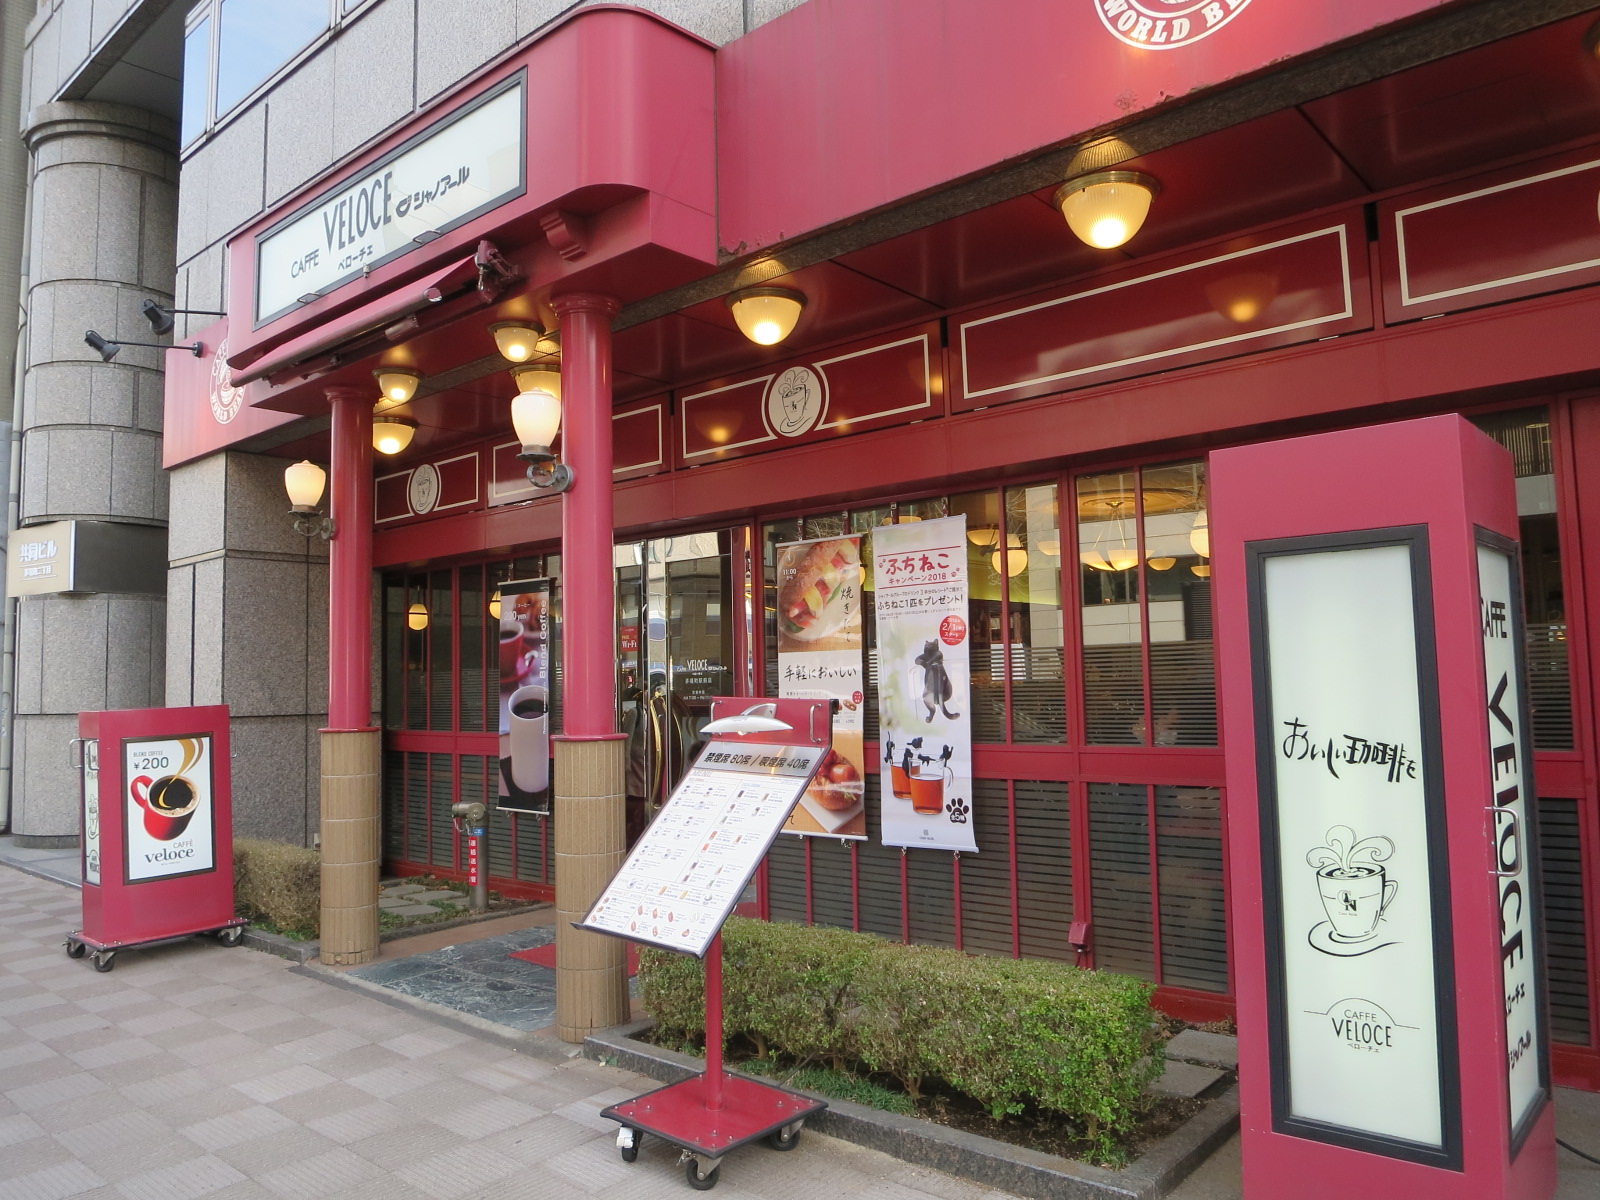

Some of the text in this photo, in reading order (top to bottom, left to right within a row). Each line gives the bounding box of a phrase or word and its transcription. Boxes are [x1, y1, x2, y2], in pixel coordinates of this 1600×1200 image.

[1103, 0, 1190, 43] WORLD
[413, 166, 470, 211] シャノアール
[323, 170, 393, 255] VELOCE
[290, 248, 320, 279] CAFFE
[337, 245, 373, 271] ベローチェ
[19, 540, 58, 563] 共同ビル
[885, 553, 950, 576] ふちねこ
[887, 572, 948, 586] キャンペーン2018
[539, 600, 547, 640] Coffee
[539, 644, 547, 679] Blend
[687, 659, 708, 671] VELOCE
[784, 664, 857, 682] 手軽においしい
[703, 752, 731, 763] 禁煙席
[730, 754, 752, 765] 80席
[787, 758, 811, 770] 40席
[1282, 717, 1417, 783] おいしい珈琲を
[145, 847, 195, 863] veloce
[1343, 1009, 1377, 1023] CAFFE
[1331, 1017, 1393, 1048] VELOCE
[1346, 1042, 1380, 1054] ベローチェ
